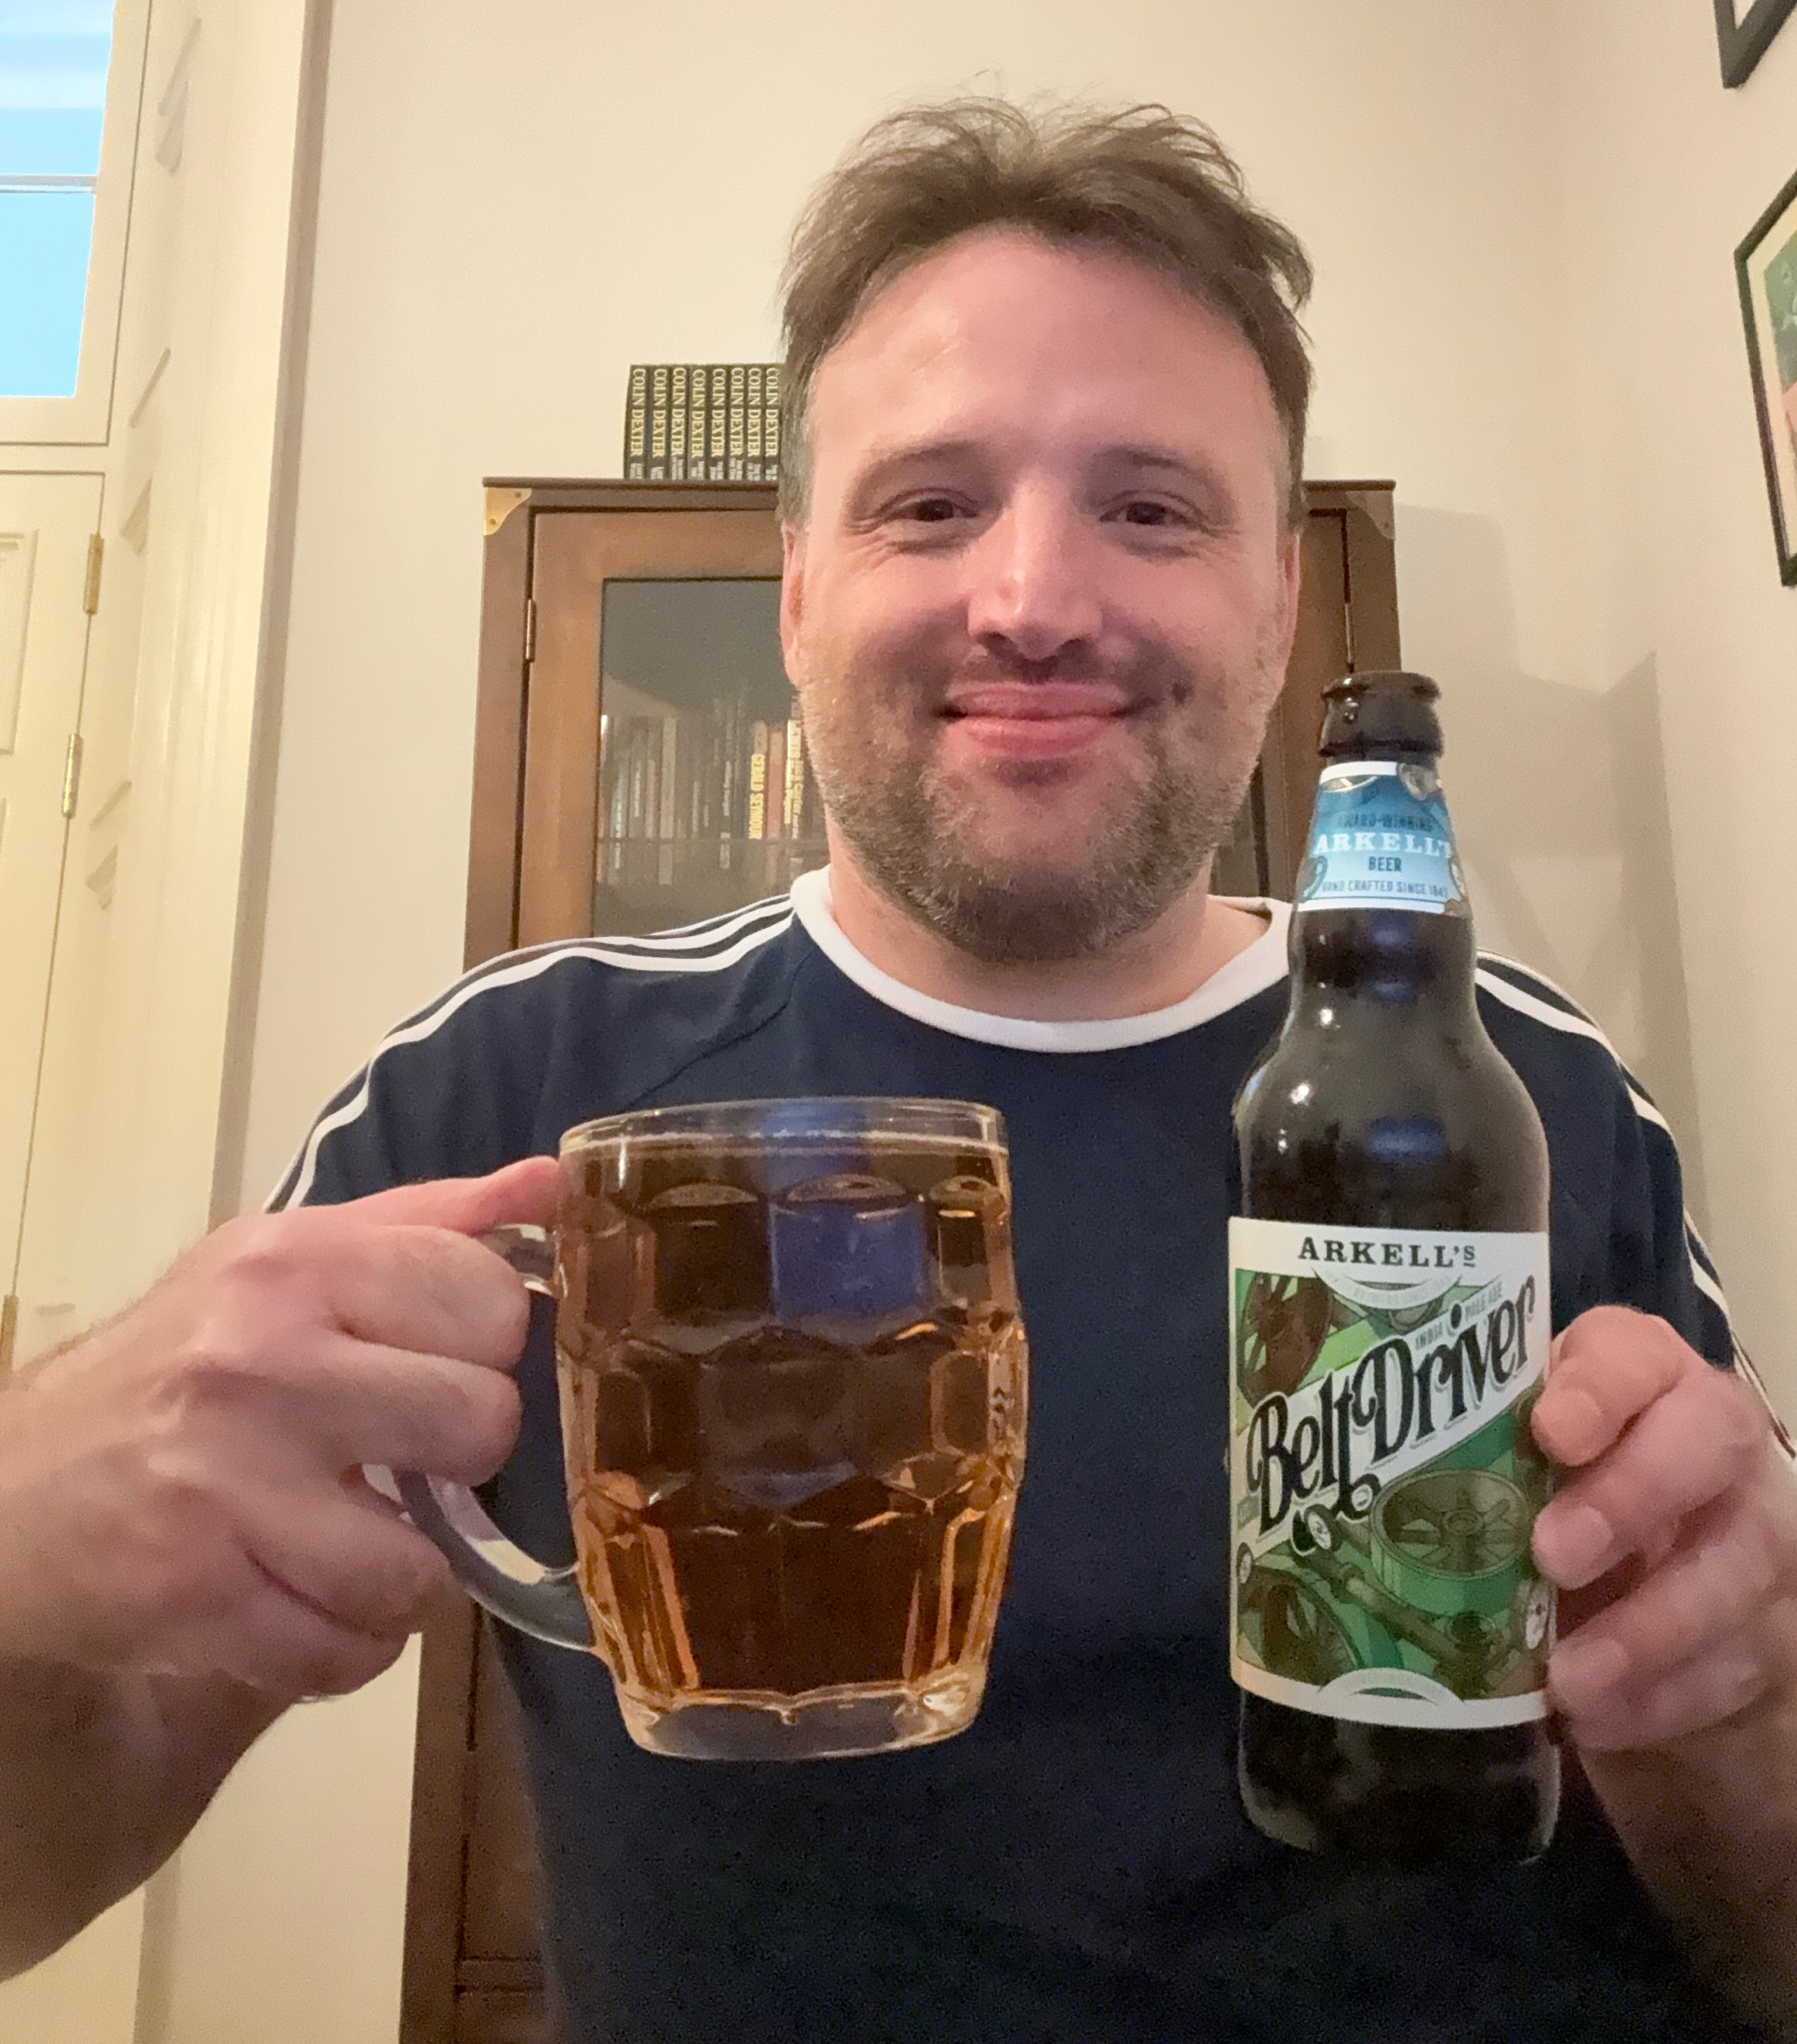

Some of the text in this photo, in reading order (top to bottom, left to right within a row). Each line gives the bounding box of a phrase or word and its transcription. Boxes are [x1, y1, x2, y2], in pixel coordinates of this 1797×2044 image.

[633, 368, 647, 406] COLIN
[654, 368, 668, 406] COLIN
[673, 367, 686, 405] COLIN
[692, 368, 705, 407] COLIN
[712, 368, 726, 406] COLIN
[730, 367, 744, 405] COLIN
[747, 367, 761, 405] COLIN
[765, 367, 778, 405] COLIN
[631, 408, 645, 457] DEXTER
[653, 409, 667, 458] DEXTER
[671, 408, 685, 457] DEXTER
[690, 410, 704, 458] DEXTER
[710, 408, 725, 457] DEXTER
[729, 408, 744, 456] DEXTER
[747, 408, 761, 457] DEXTER
[765, 408, 778, 457] DEXTER
[748, 753, 765, 839] GERALD SEYMOUR
[1314, 831, 1452, 858] ARKELL'S
[1368, 856, 1402, 871] BEER
[1347, 879, 1394, 891] CRAFTED
[1397, 880, 1427, 894] SINCE
[1297, 1237, 1476, 1268] ARKELL'S
[1246, 1274, 1536, 1537] Belt Driver
